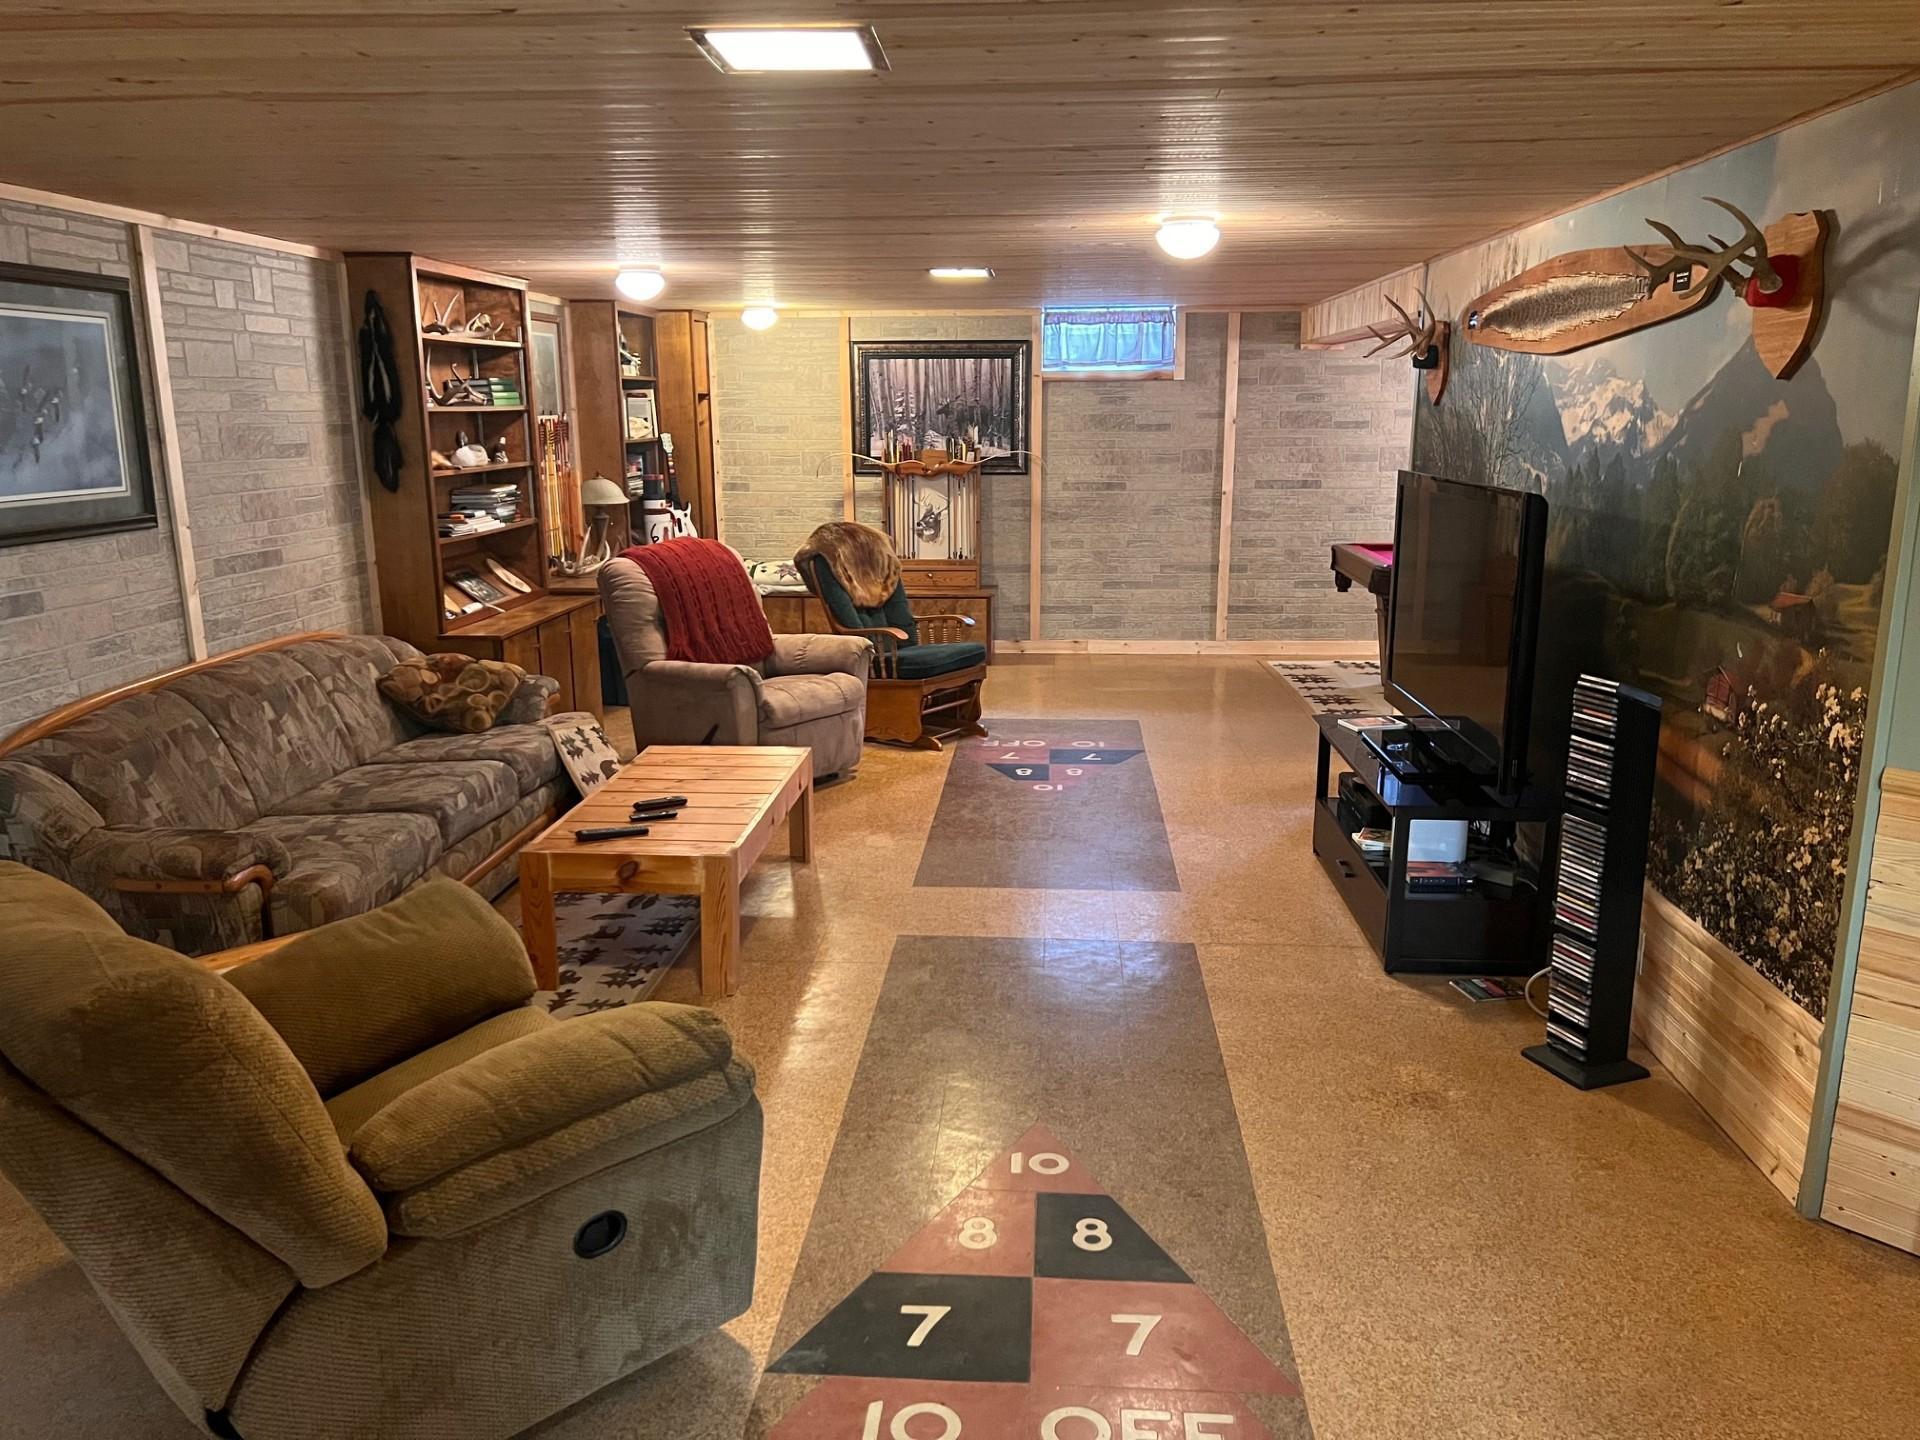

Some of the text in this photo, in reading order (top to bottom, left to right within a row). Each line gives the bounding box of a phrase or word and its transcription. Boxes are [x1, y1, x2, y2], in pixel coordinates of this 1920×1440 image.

[1015, 768, 1033, 776] 8
[1065, 768, 1083, 776] 8
[1010, 1151, 1070, 1175] 10
[958, 1216, 997, 1250] 8
[1072, 1217, 1113, 1251] 8
[900, 1304, 951, 1347] 7
[1111, 1314, 1163, 1356] 7
[861, 1400, 1236, 1440] 10 OFF
